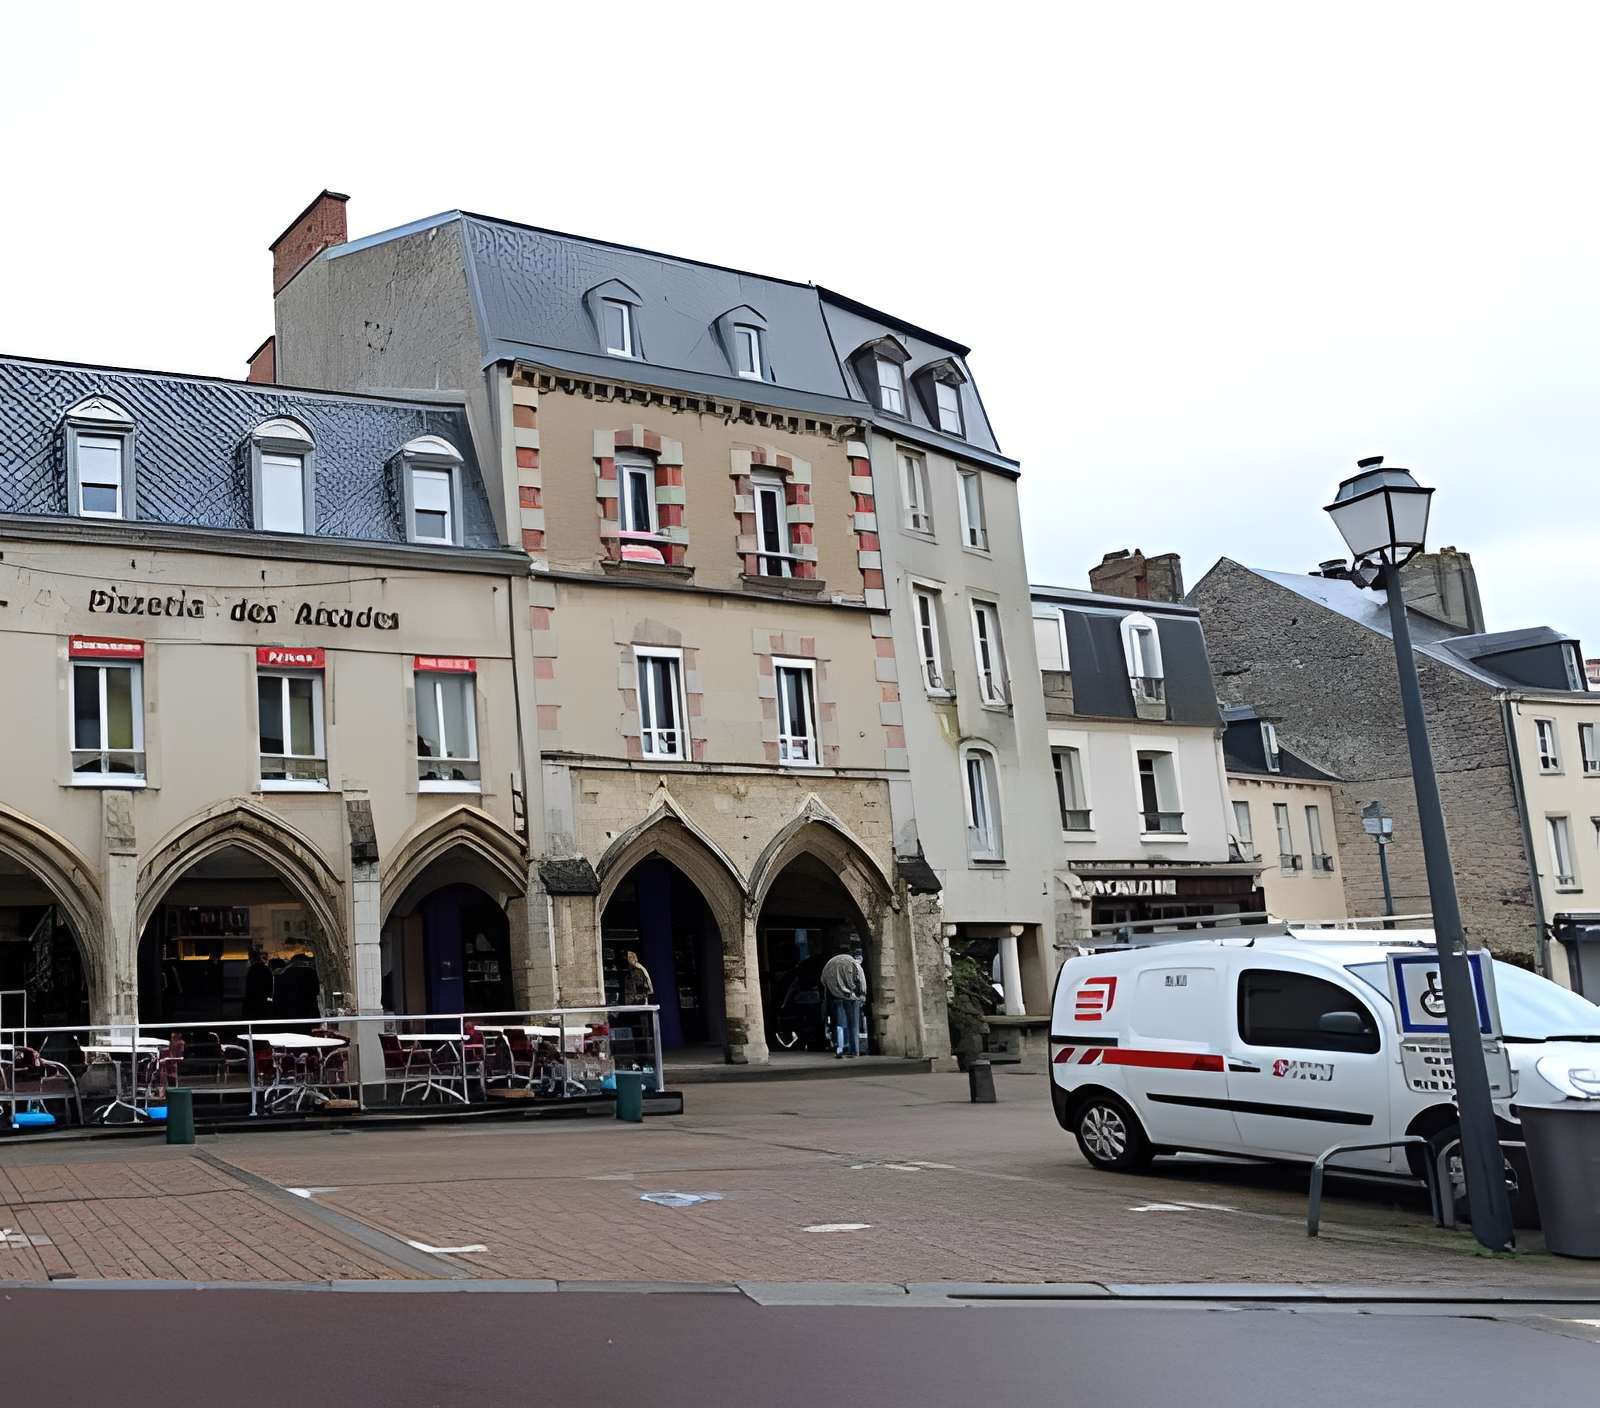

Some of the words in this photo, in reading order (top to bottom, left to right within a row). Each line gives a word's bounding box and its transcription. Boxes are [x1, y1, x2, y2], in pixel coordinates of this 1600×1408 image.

[87, 586, 205, 619] Pizzeria
[230, 596, 279, 624] des
[295, 602, 400, 630] Arcades
